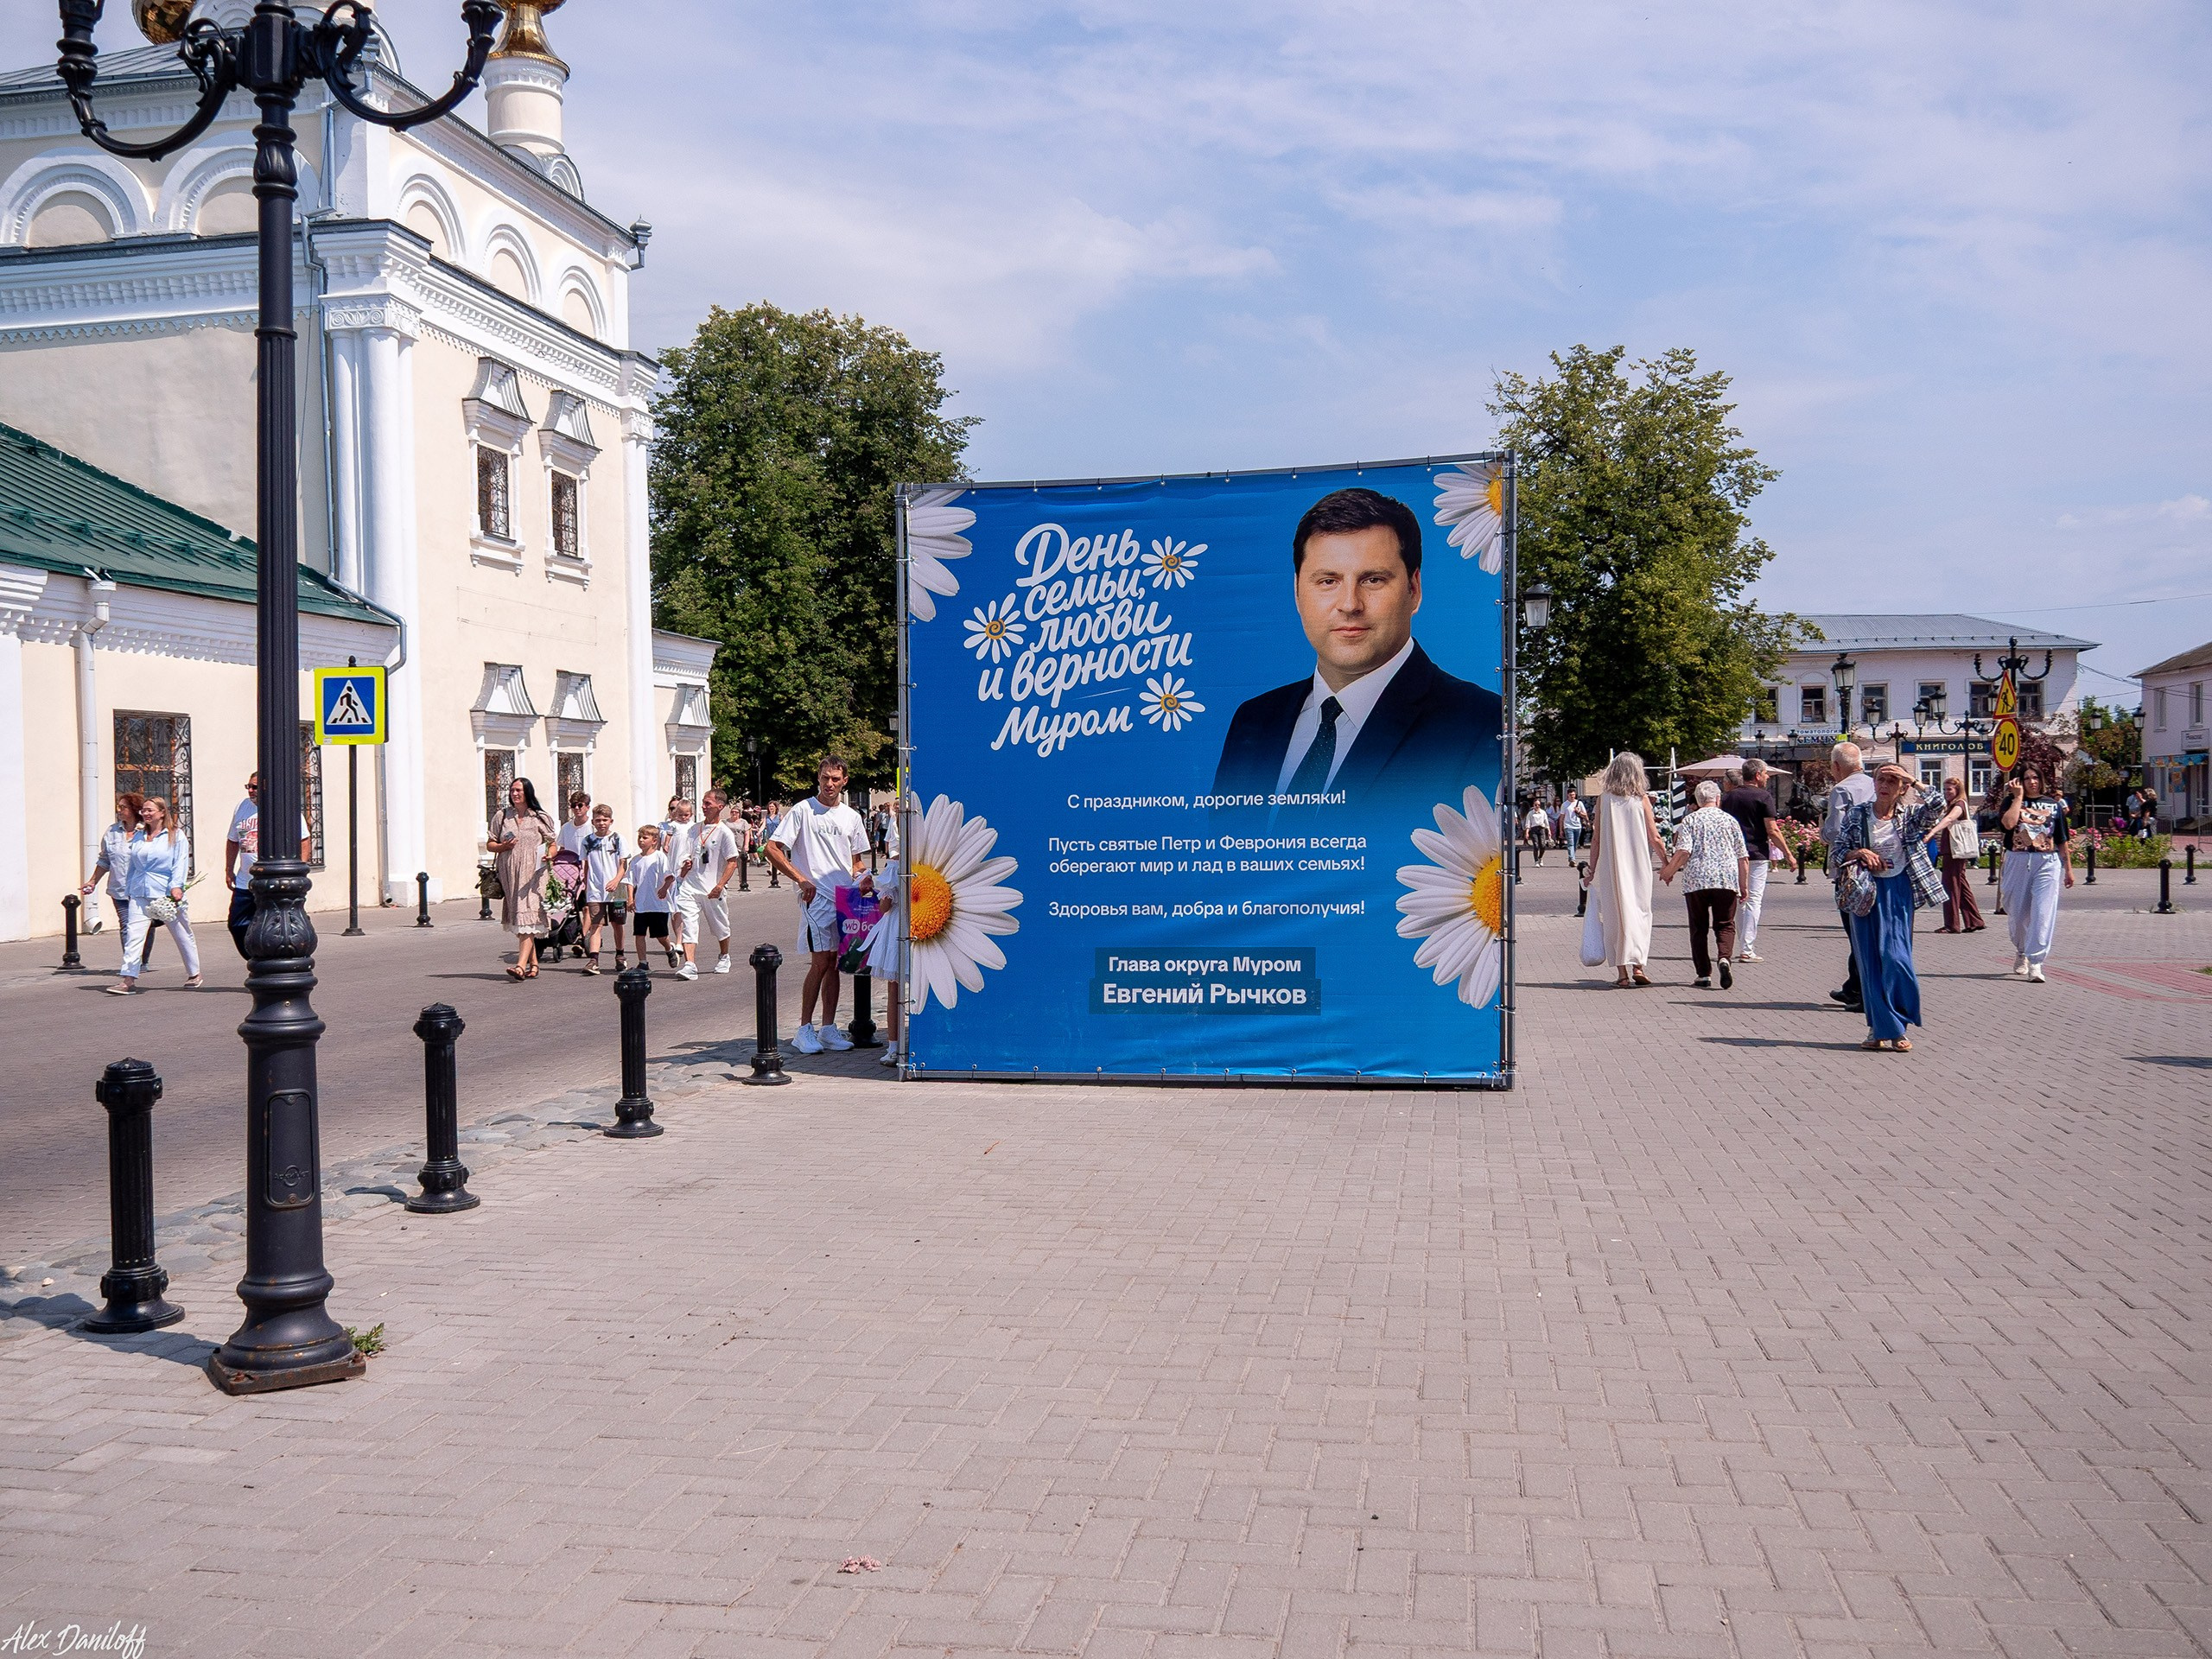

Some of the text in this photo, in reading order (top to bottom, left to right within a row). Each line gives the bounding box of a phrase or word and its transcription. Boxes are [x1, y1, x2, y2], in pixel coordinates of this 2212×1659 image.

[1014, 523, 1141, 587] День
[1024, 569, 1146, 621] семьи,
[1029, 599, 1172, 652] любви
[978, 632, 1192, 708] и верности
[990, 705, 1134, 758] Муром
[1999, 733, 2015, 756] 40
[1067, 790, 1346, 811] С праздником, дорогие земляки!
[1048, 835, 1367, 855] Пусть святые Петр и Феврония всегда
[1049, 856, 1365, 875] оберегают мир и лад в ваших семьях!
[1048, 899, 1365, 919] Здоровья вам, добра и благополучия!
[1109, 957, 1301, 976] Глава округа Муром
[1103, 982, 1307, 1004] Евгений Рычков
